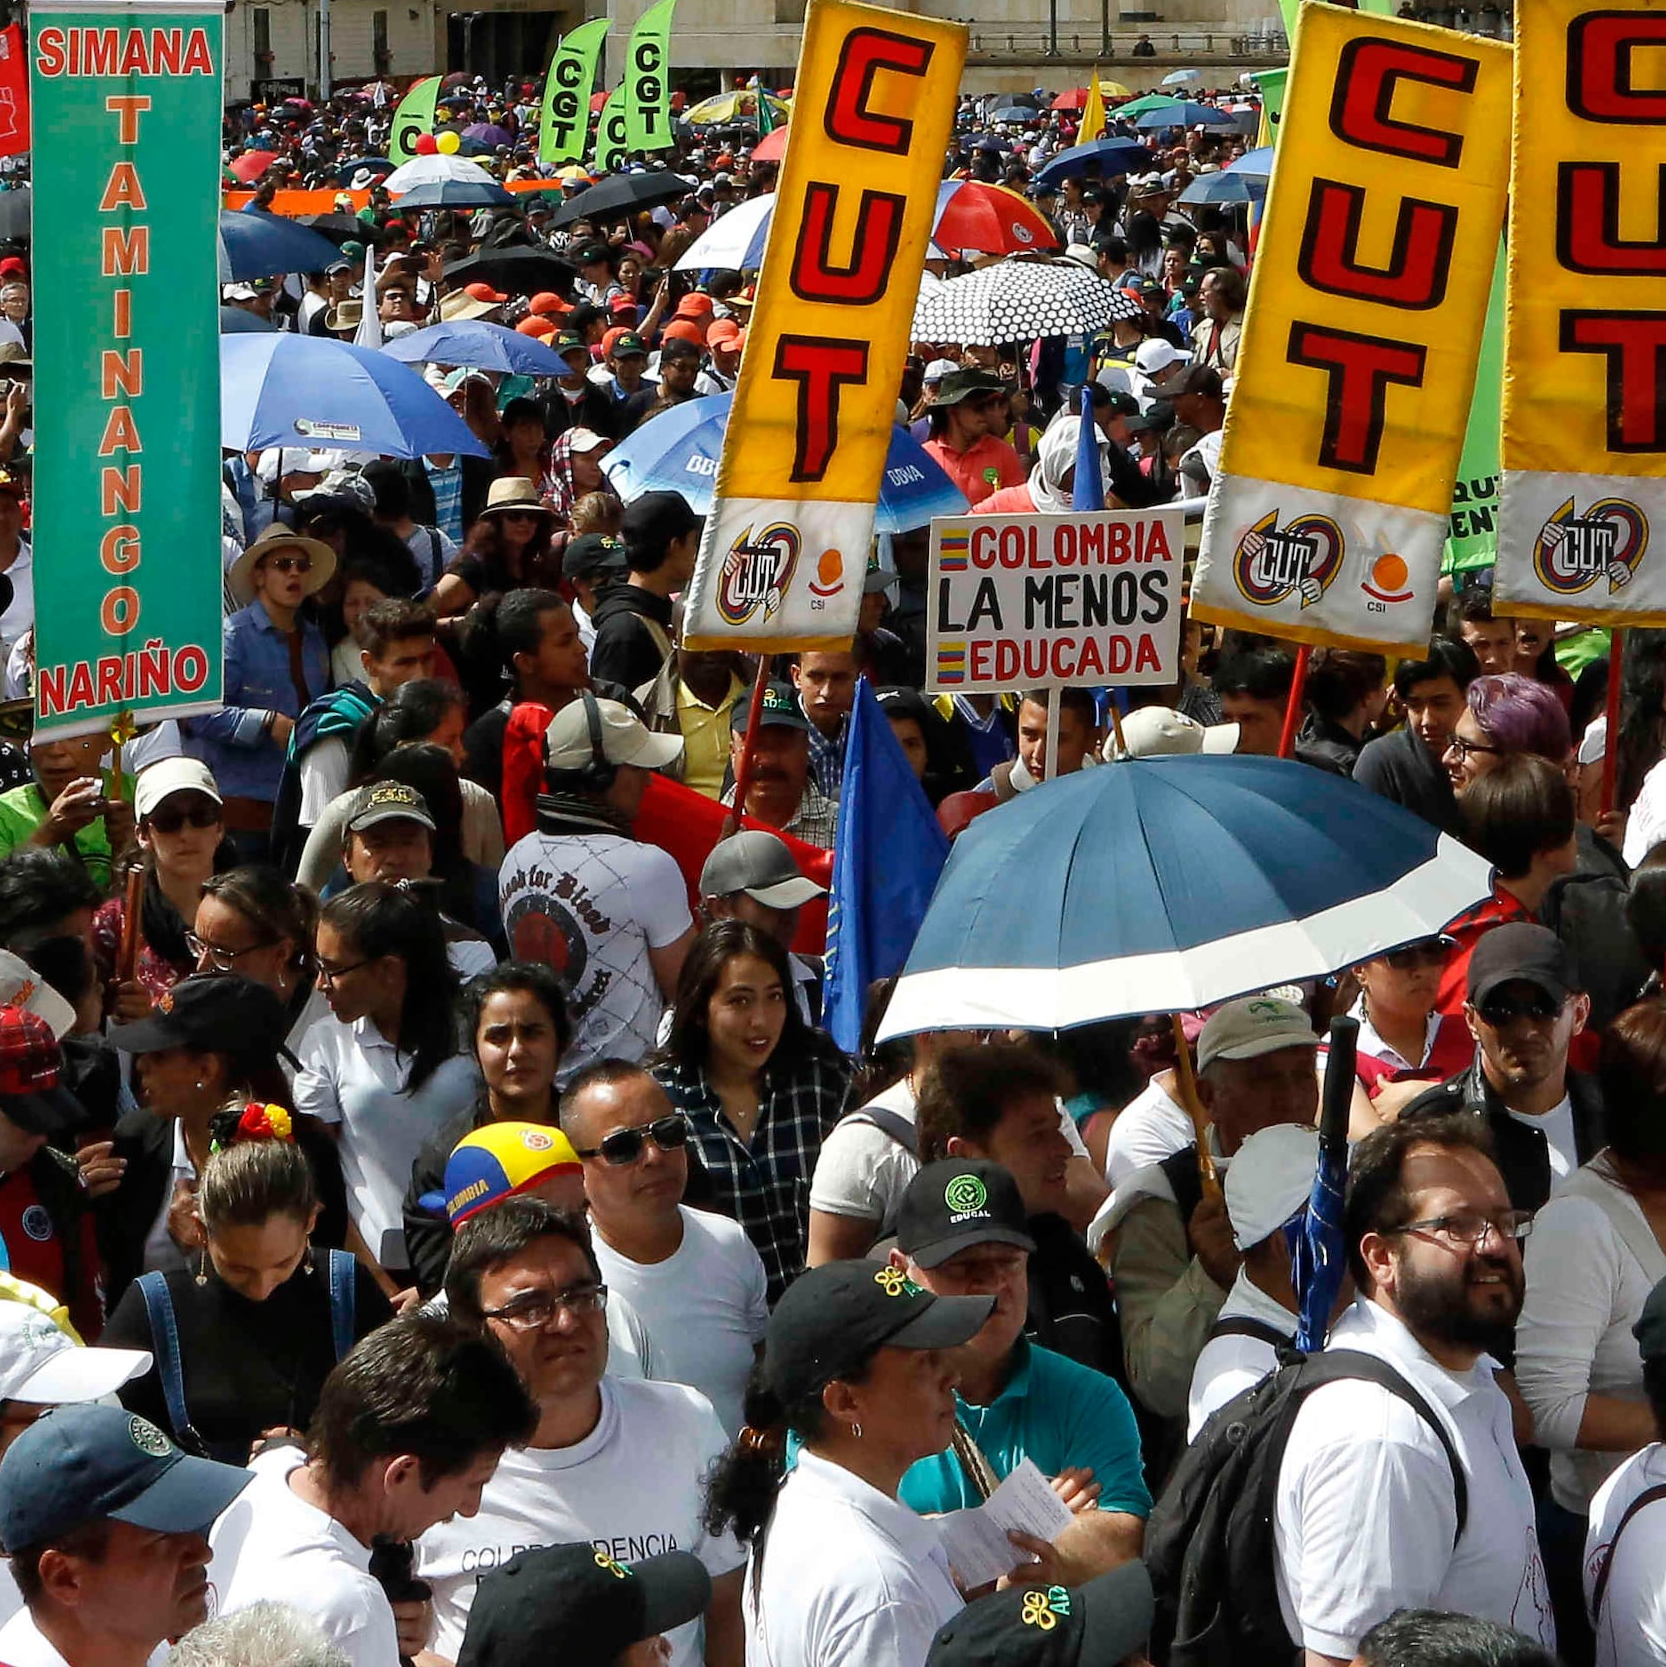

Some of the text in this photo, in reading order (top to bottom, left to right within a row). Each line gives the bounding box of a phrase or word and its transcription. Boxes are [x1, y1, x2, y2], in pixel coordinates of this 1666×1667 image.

[36, 27, 214, 78] SIMANA
[551, 58, 583, 150] CGT
[634, 43, 661, 134] CGT
[771, 27, 936, 483] CUT
[1287, 36, 1480, 476] CUT
[98, 95, 151, 637] TAMINANGO
[685, 455, 720, 478] BB
[887, 465, 925, 486] BBVA
[971, 520, 1173, 570] COLOMBIA
[1258, 536, 1311, 588] CUT
[1561, 525, 1613, 571] CUT
[734, 551, 776, 600] CUT
[938, 569, 1169, 632] LA MENOS
[811, 599, 825, 610] CSI
[1367, 602, 1386, 613] CSI
[38, 641, 209, 717] NARIÑO
[970, 634, 1162, 681] EDUCADA
[949, 1209, 992, 1224] EDUCAL
